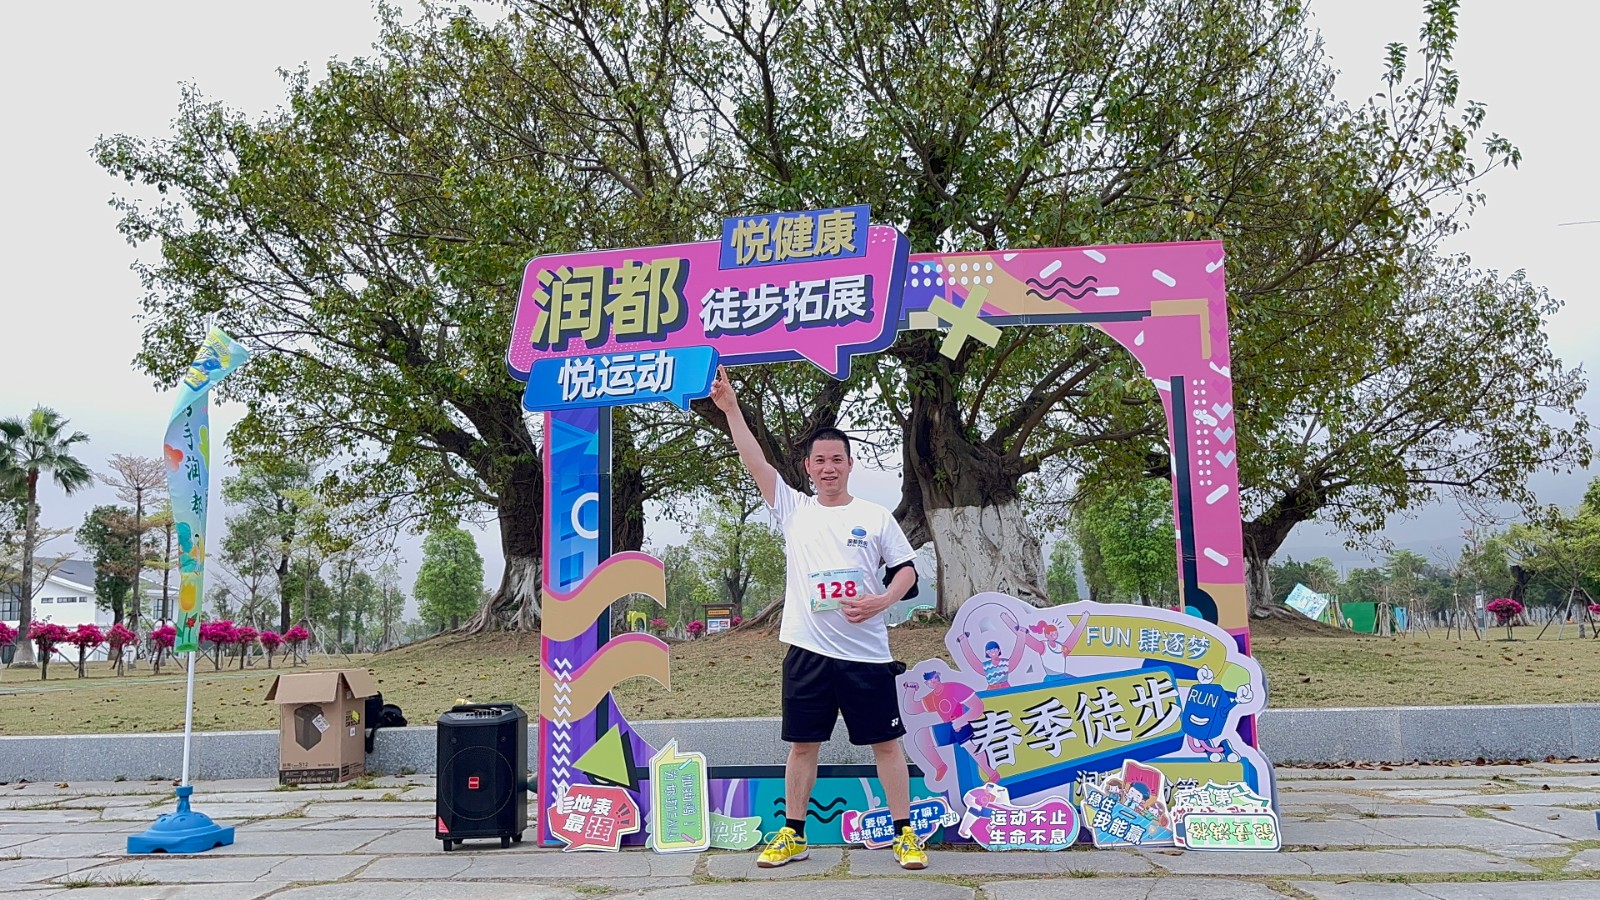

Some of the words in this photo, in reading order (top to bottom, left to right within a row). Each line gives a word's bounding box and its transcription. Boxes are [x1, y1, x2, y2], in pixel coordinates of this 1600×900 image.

[730, 209, 857, 266] 悦健康
[529, 256, 688, 345] 润都
[699, 273, 868, 334] 徒步拓展
[558, 350, 676, 403] 悦运动
[817, 580, 858, 600] 128
[1085, 625, 1132, 648] FUN
[1137, 629, 1212, 660] 肆逐梦
[1188, 688, 1220, 708] RUN
[969, 677, 1182, 769] 春季徒步
[573, 793, 613, 816] 地表
[1087, 790, 1115, 813] 稳住
[1174, 787, 1252, 808] 友谊第一
[563, 813, 615, 842] 最强
[989, 810, 1067, 827] 运动不止
[1093, 811, 1146, 846] 我能赢
[989, 828, 1067, 845] 生命不息
